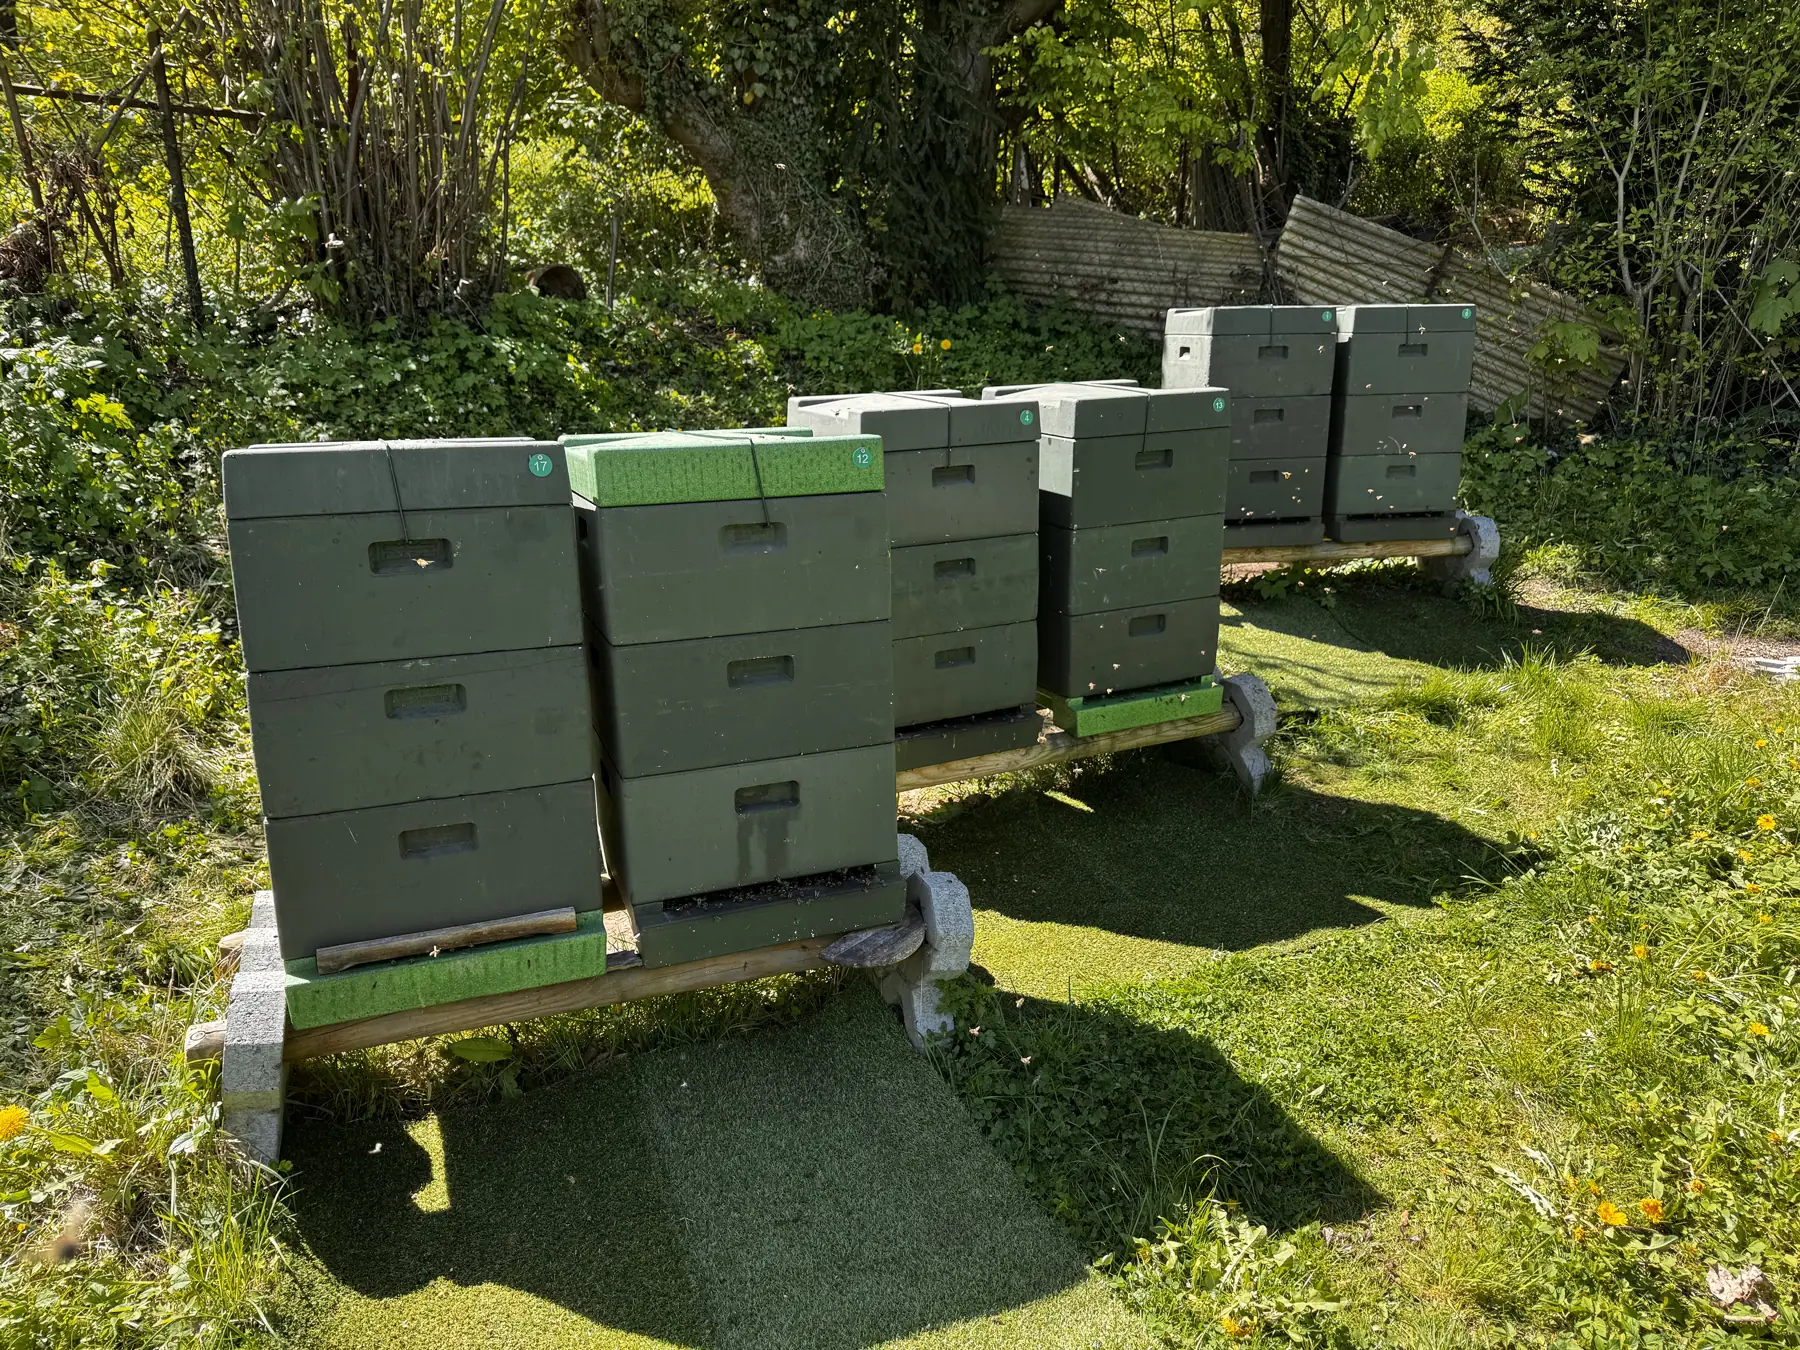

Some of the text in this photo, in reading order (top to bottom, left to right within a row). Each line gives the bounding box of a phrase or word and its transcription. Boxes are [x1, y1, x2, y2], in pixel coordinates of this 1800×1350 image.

[1215, 401, 1223, 409] 13
[1024, 414, 1030, 422] 4
[856, 454, 869, 464] 12
[533, 461, 548, 472] 17
